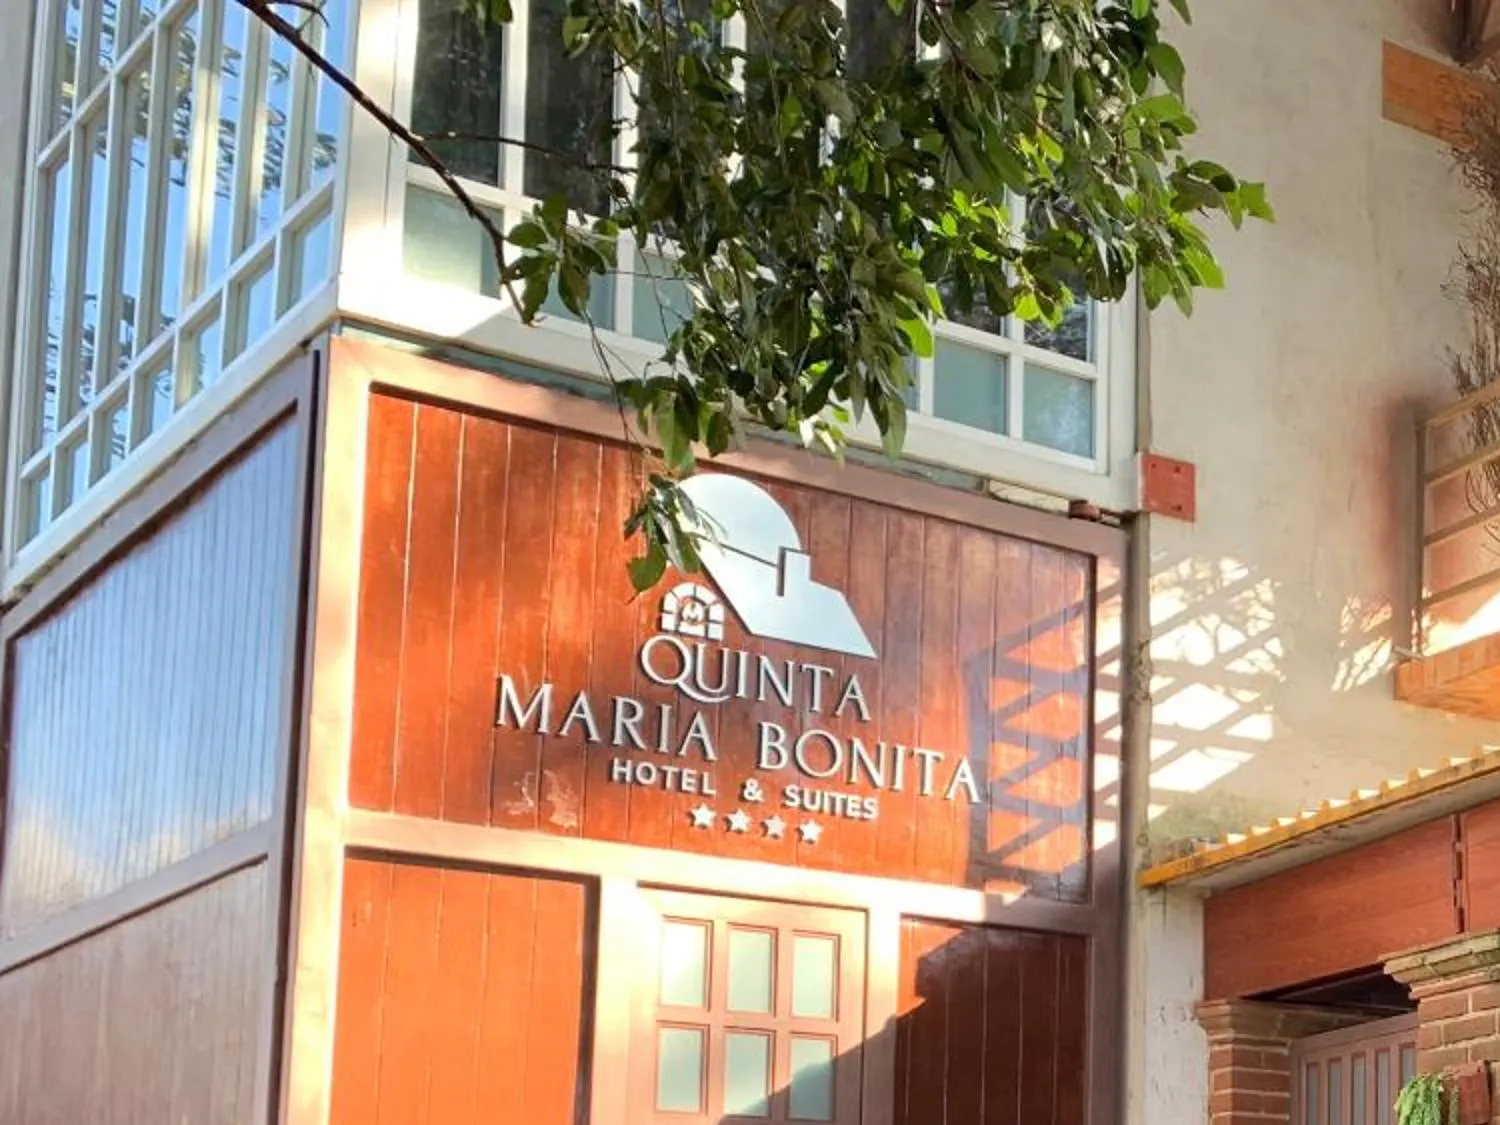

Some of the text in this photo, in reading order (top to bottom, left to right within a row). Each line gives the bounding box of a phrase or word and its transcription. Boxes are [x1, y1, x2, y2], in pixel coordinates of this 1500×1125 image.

[641, 635, 873, 721] QUINTA
[495, 674, 982, 803] MARIA BONITA
[611, 758, 879, 820] HOTEL & SUITES
